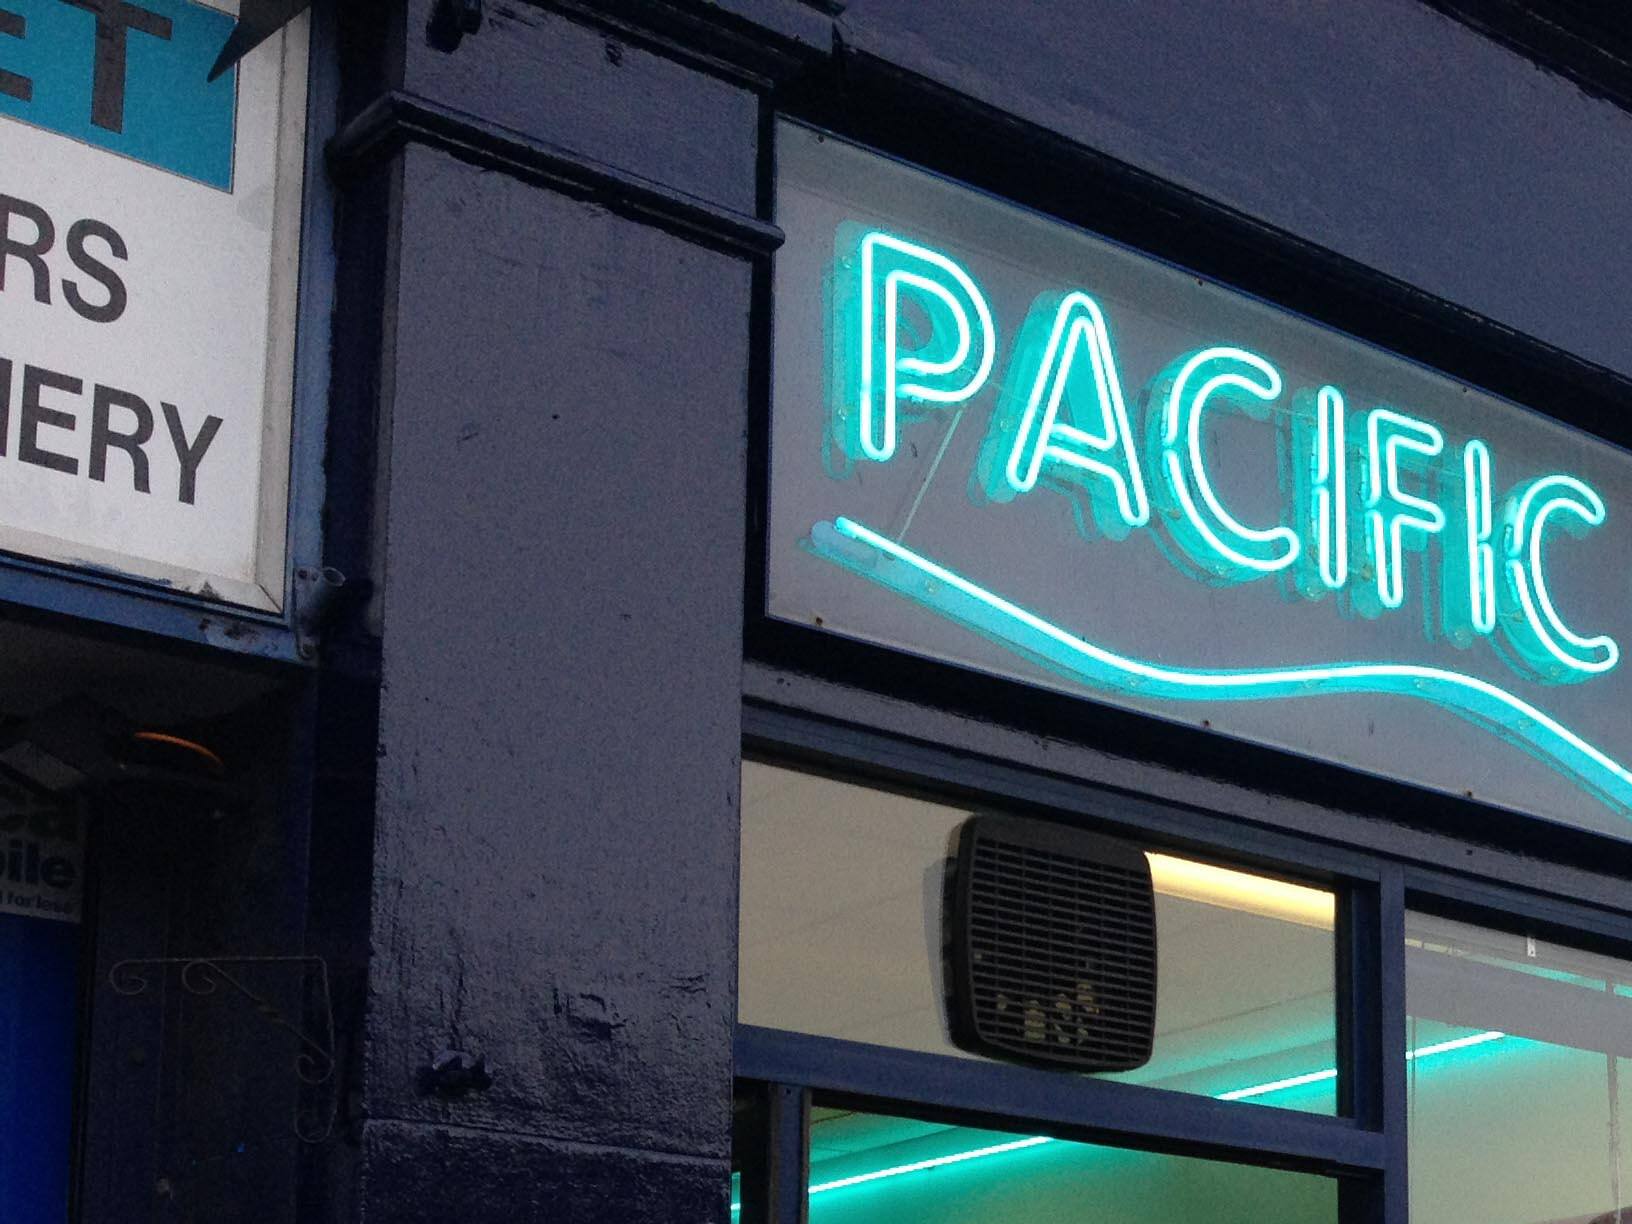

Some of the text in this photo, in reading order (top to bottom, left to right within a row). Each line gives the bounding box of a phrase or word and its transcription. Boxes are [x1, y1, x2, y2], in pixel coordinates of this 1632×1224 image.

[0, 193, 129, 323] RS
[0, 357, 224, 505] ERY
[863, 231, 1618, 672] PACIFIC
[0, 837, 76, 890] ile
